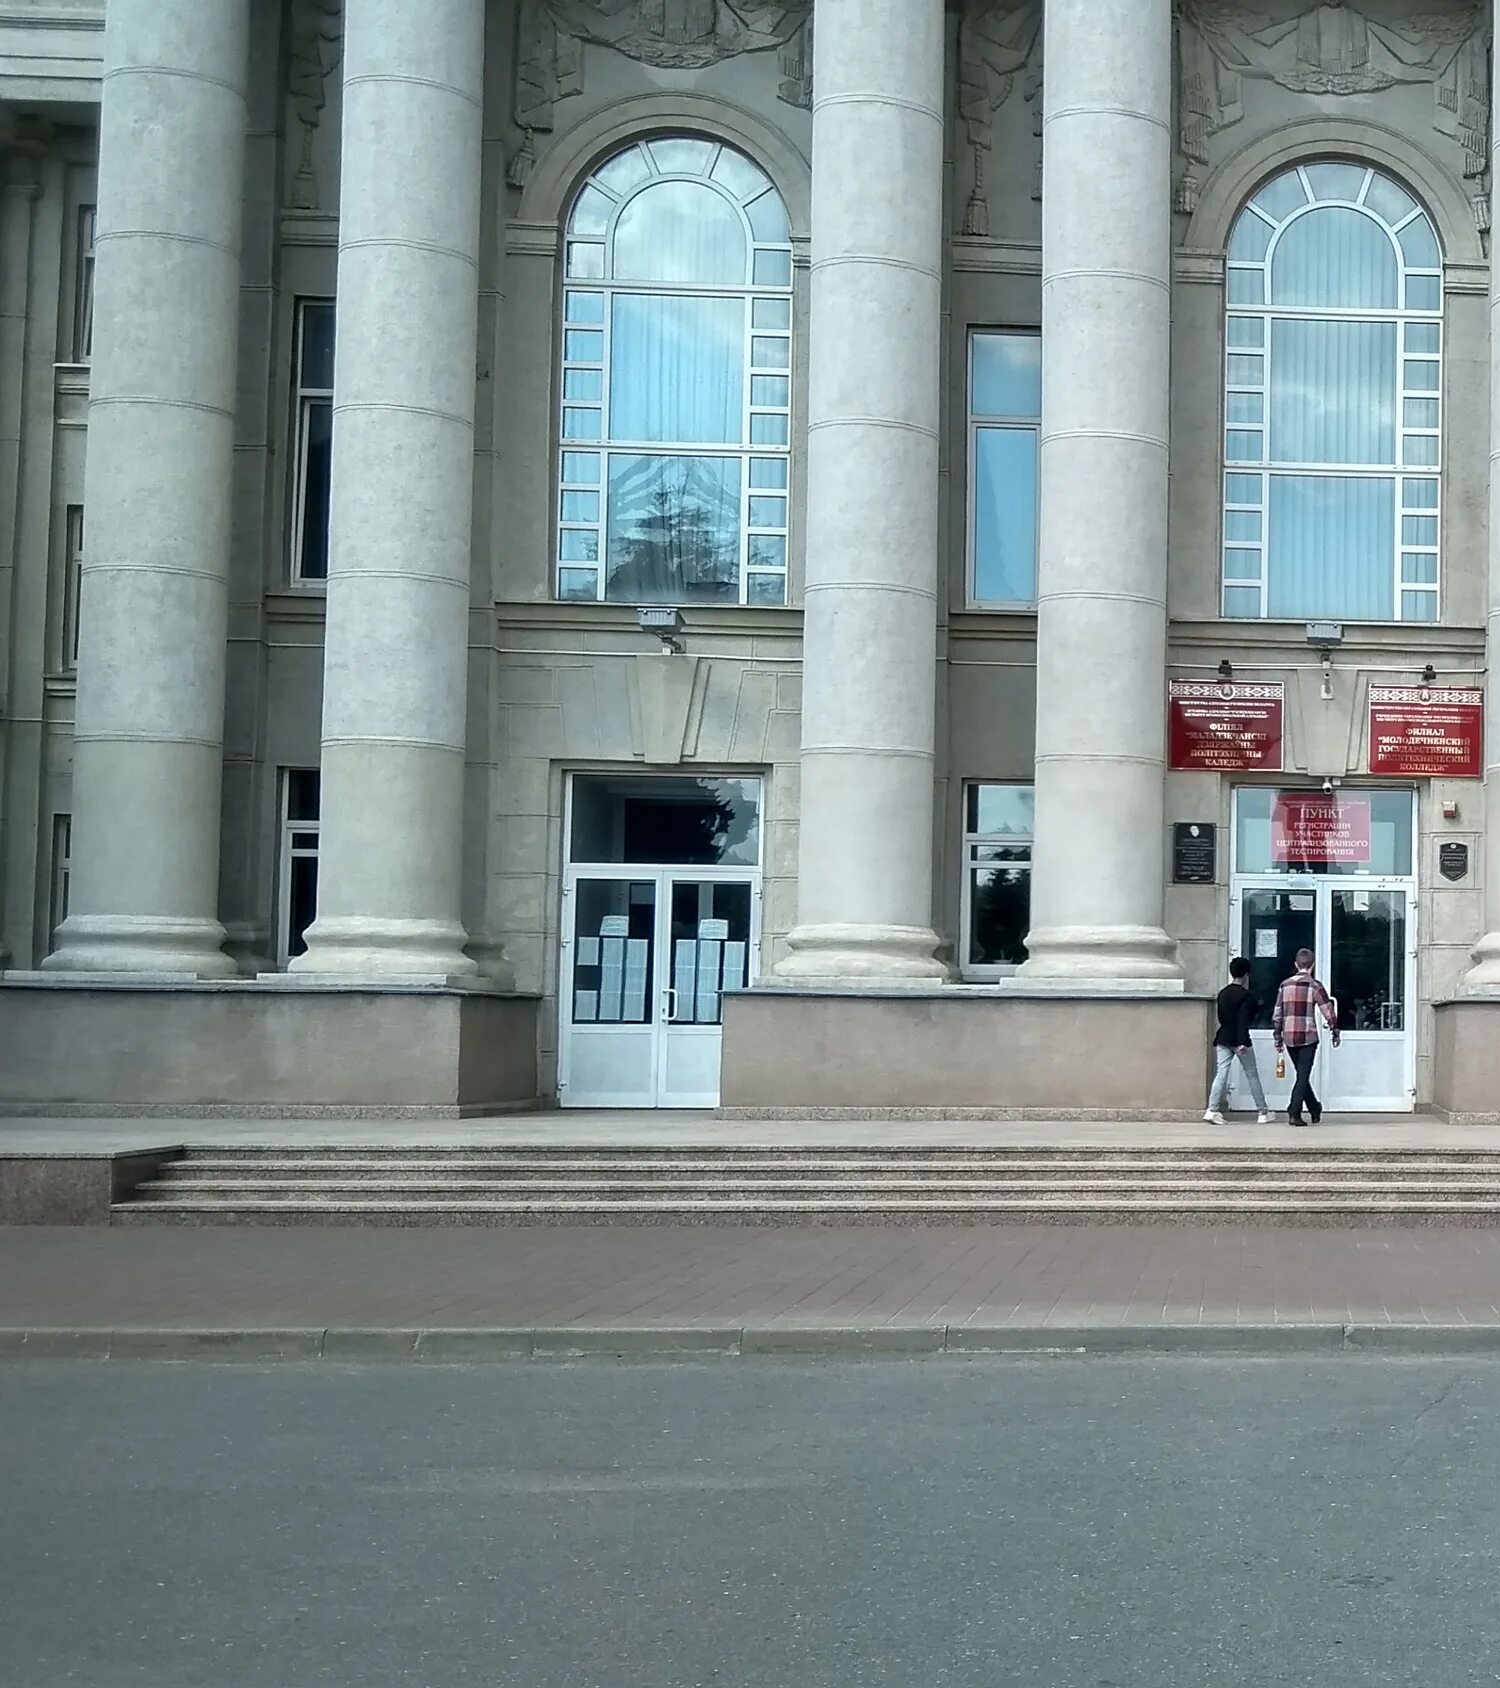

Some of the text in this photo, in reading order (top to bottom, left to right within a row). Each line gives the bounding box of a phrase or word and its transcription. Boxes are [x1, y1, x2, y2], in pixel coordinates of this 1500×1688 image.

[1405, 728, 1445, 736] ФИЛИАЛ
[1378, 745, 1470, 754] ГОСУДАРСТВЕННЫЙ
[1300, 808, 1345, 819] ПУНКТ
[1293, 821, 1351, 830] РЕГИСТРАЦИИ
[1295, 830, 1350, 838] УЧАСТНИКОВ
[1276, 839, 1369, 848] ЦЕНТРАЛИЗОВАННОГО
[1290, 848, 1355, 856] ТЕСТИРОВАНИЯ
